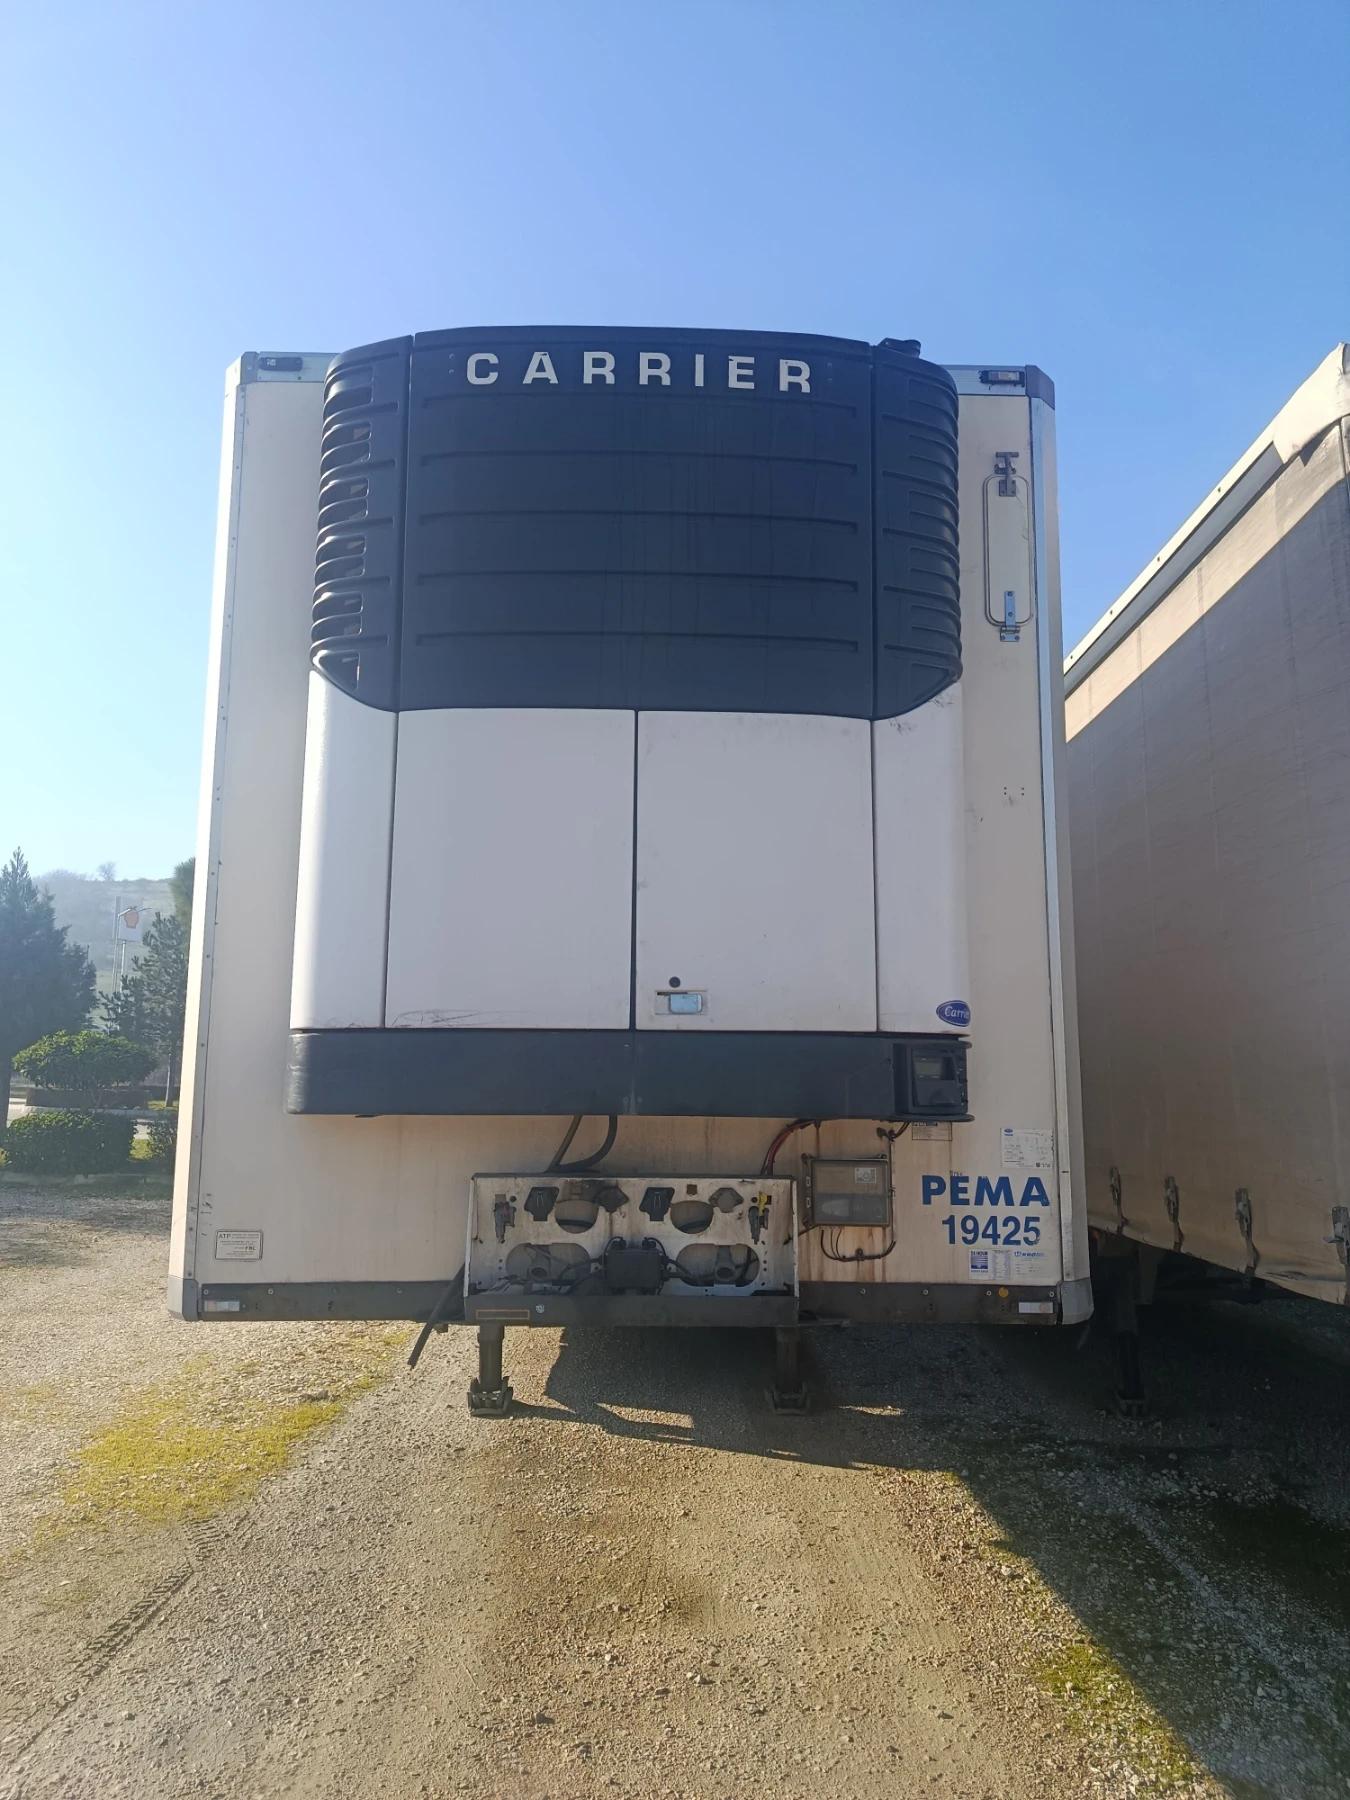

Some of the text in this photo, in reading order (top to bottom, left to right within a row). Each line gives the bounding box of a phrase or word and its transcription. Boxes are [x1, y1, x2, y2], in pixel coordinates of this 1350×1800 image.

[466, 351, 811, 394] CARRIER
[921, 1174, 1051, 1207] PEMA
[941, 1214, 1041, 1246] 19425
